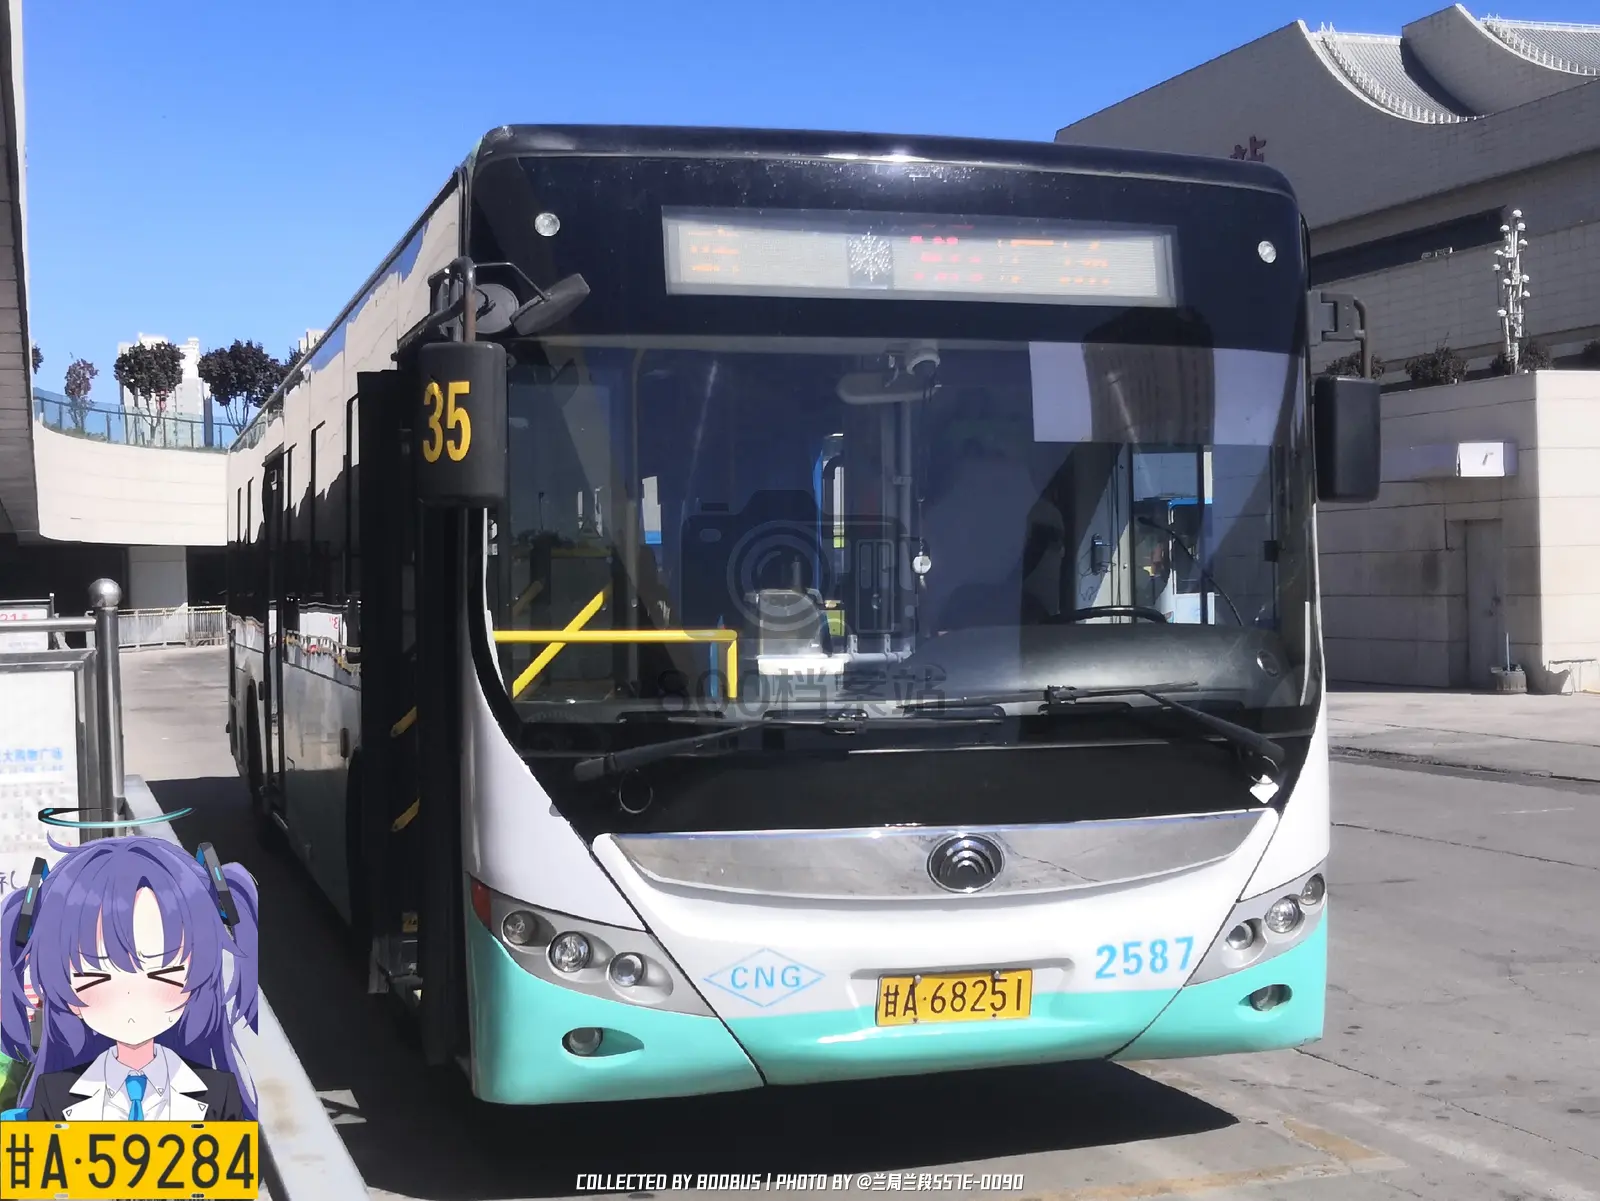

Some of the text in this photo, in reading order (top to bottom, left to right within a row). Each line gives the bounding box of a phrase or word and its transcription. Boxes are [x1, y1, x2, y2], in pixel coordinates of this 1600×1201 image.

[423, 381, 472, 463] 35
[730, 965, 801, 990] CNG
[1095, 936, 1194, 979] 2587
